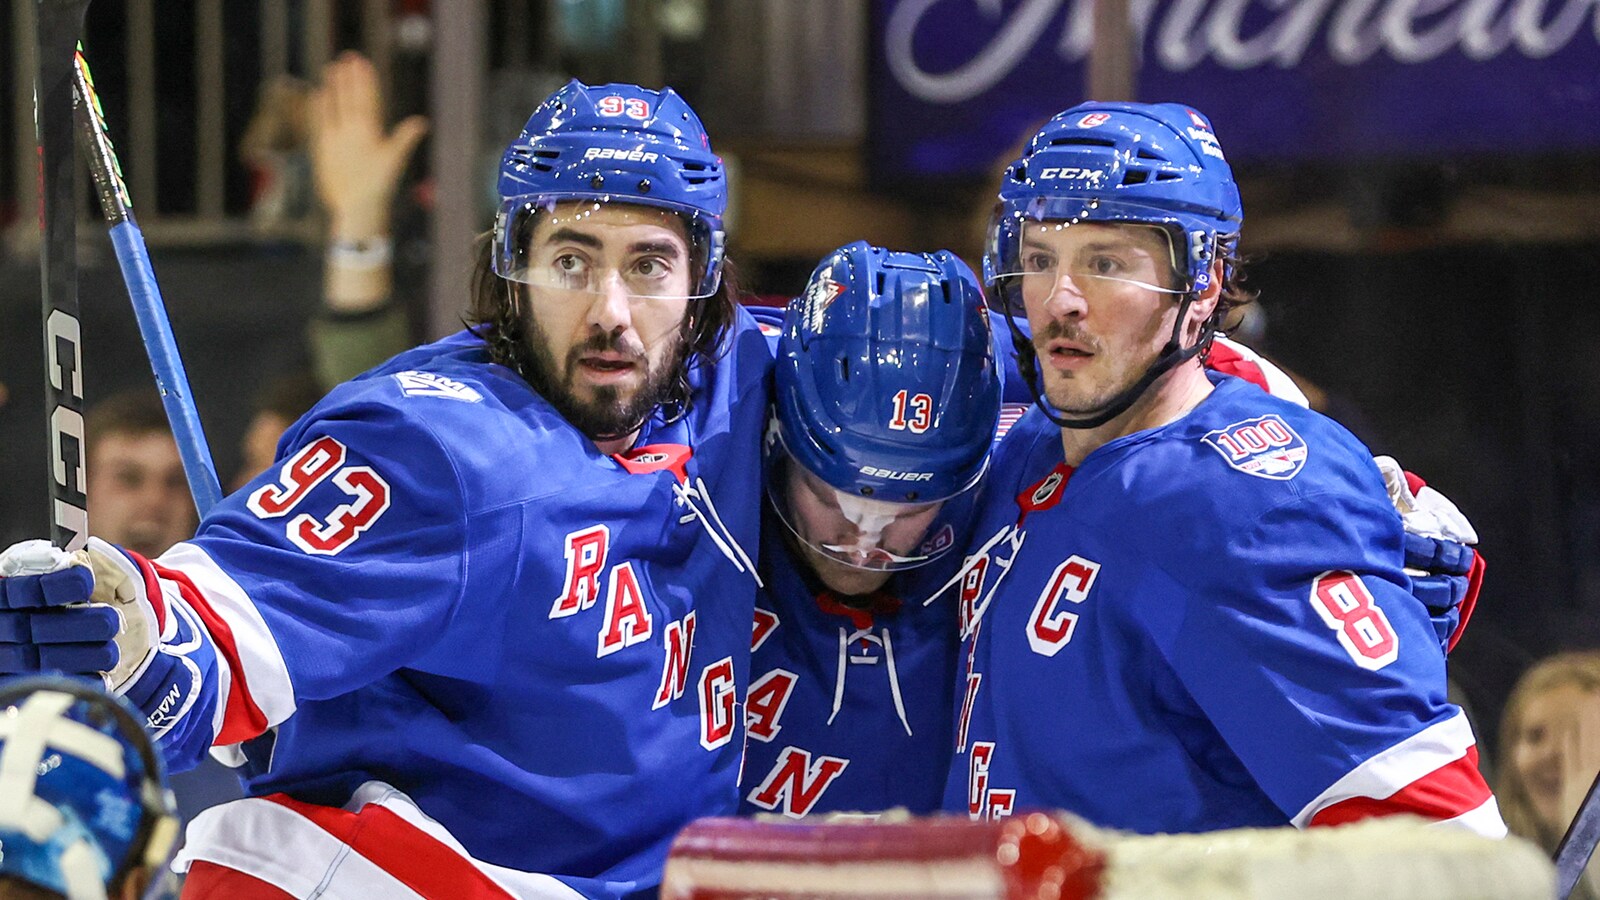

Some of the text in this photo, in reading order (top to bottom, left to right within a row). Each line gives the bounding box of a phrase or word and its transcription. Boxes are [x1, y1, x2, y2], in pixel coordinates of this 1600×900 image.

[599, 96, 649, 119] 93
[1077, 113, 1111, 129] C
[1039, 168, 1103, 184] CCM
[888, 389, 932, 434] 13
[1217, 419, 1293, 461] 100
[859, 465, 934, 482] BAUER
[246, 435, 391, 556] 93
[1026, 554, 1101, 657] C
[1309, 569, 1399, 672] 8
[549, 524, 749, 787] RANG
